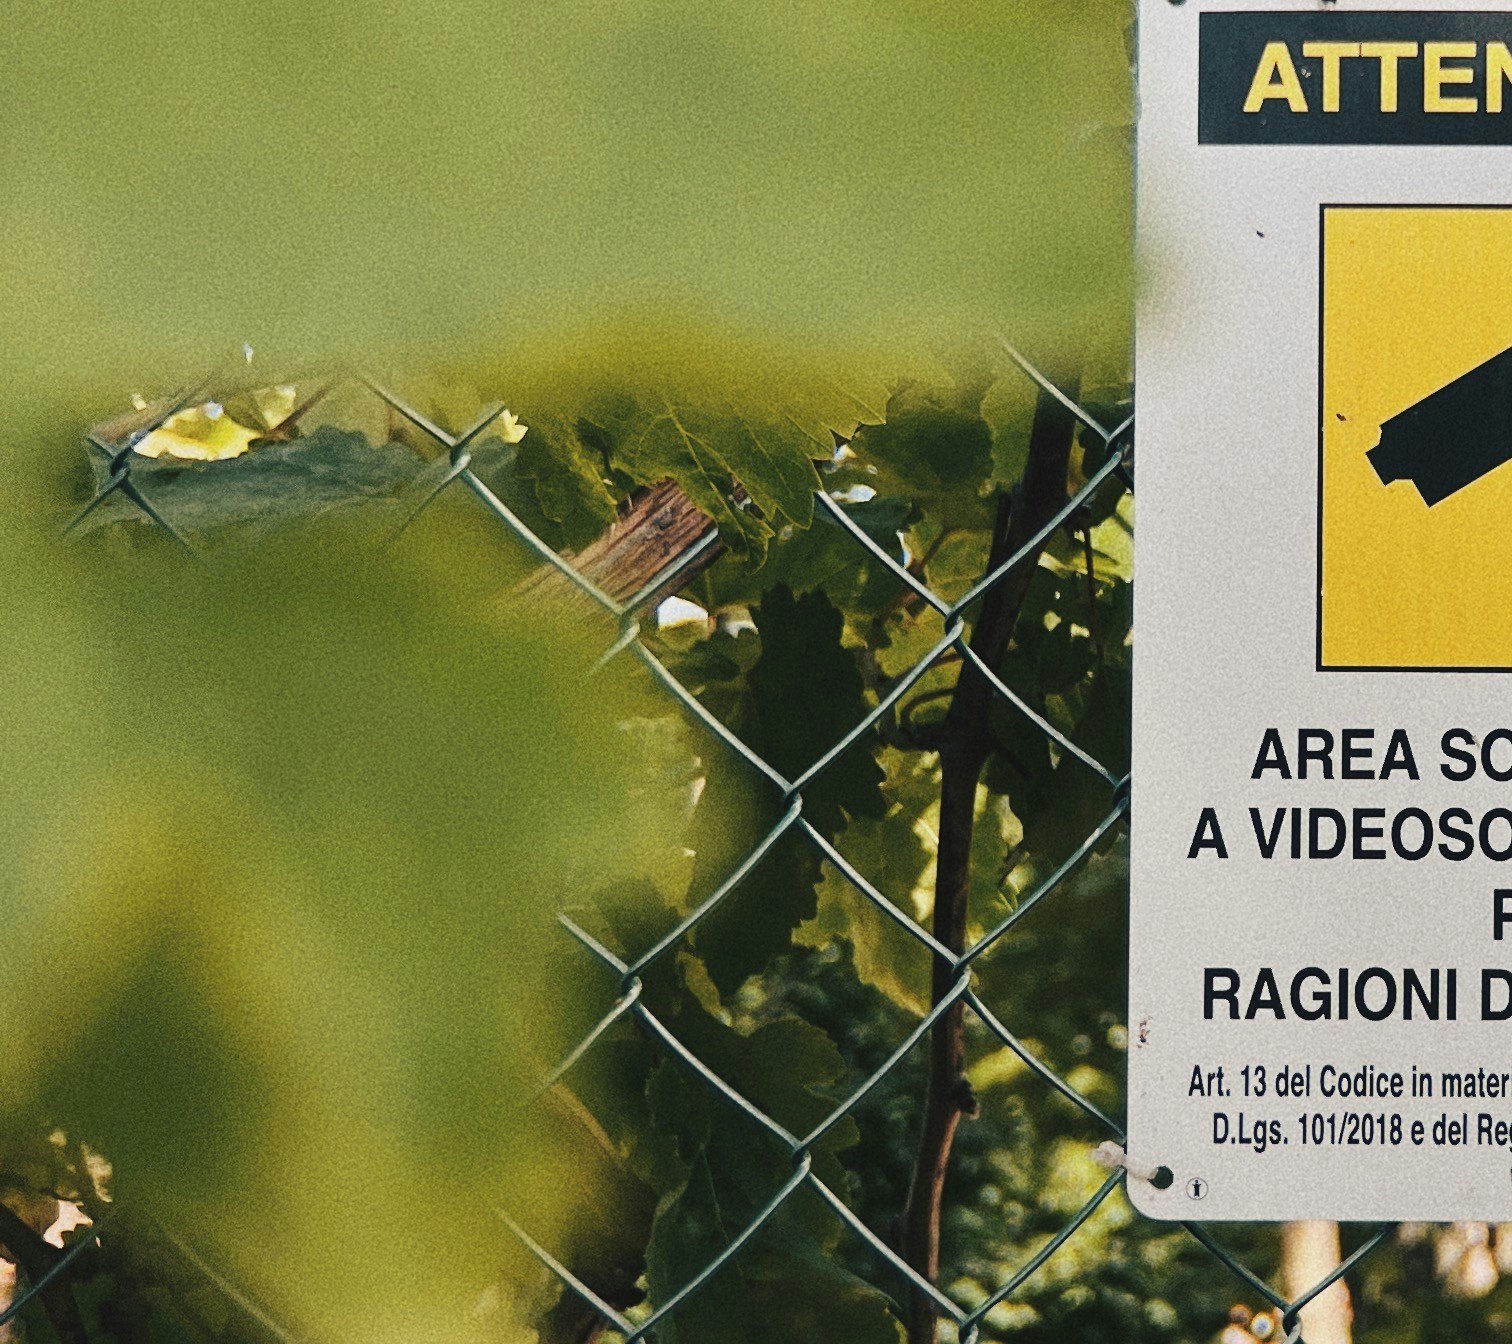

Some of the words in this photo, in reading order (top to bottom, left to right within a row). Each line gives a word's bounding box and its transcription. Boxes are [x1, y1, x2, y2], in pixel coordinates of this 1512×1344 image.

[1251, 728, 1422, 782] AREA
[1187, 807, 1230, 859] A
[1203, 967, 1458, 1022] RAGIONI
[1188, 1064, 1231, 1097] Art.
[1241, 1065, 1266, 1097] 13
[1275, 1065, 1311, 1097] del
[1320, 1065, 1403, 1098] Codice
[1412, 1065, 1433, 1097] in
[1213, 1112, 1288, 1153] D.Lgs.
[1299, 1112, 1402, 1145] 101/2018
[1411, 1120, 1425, 1145] e
[1433, 1113, 1467, 1145] del
